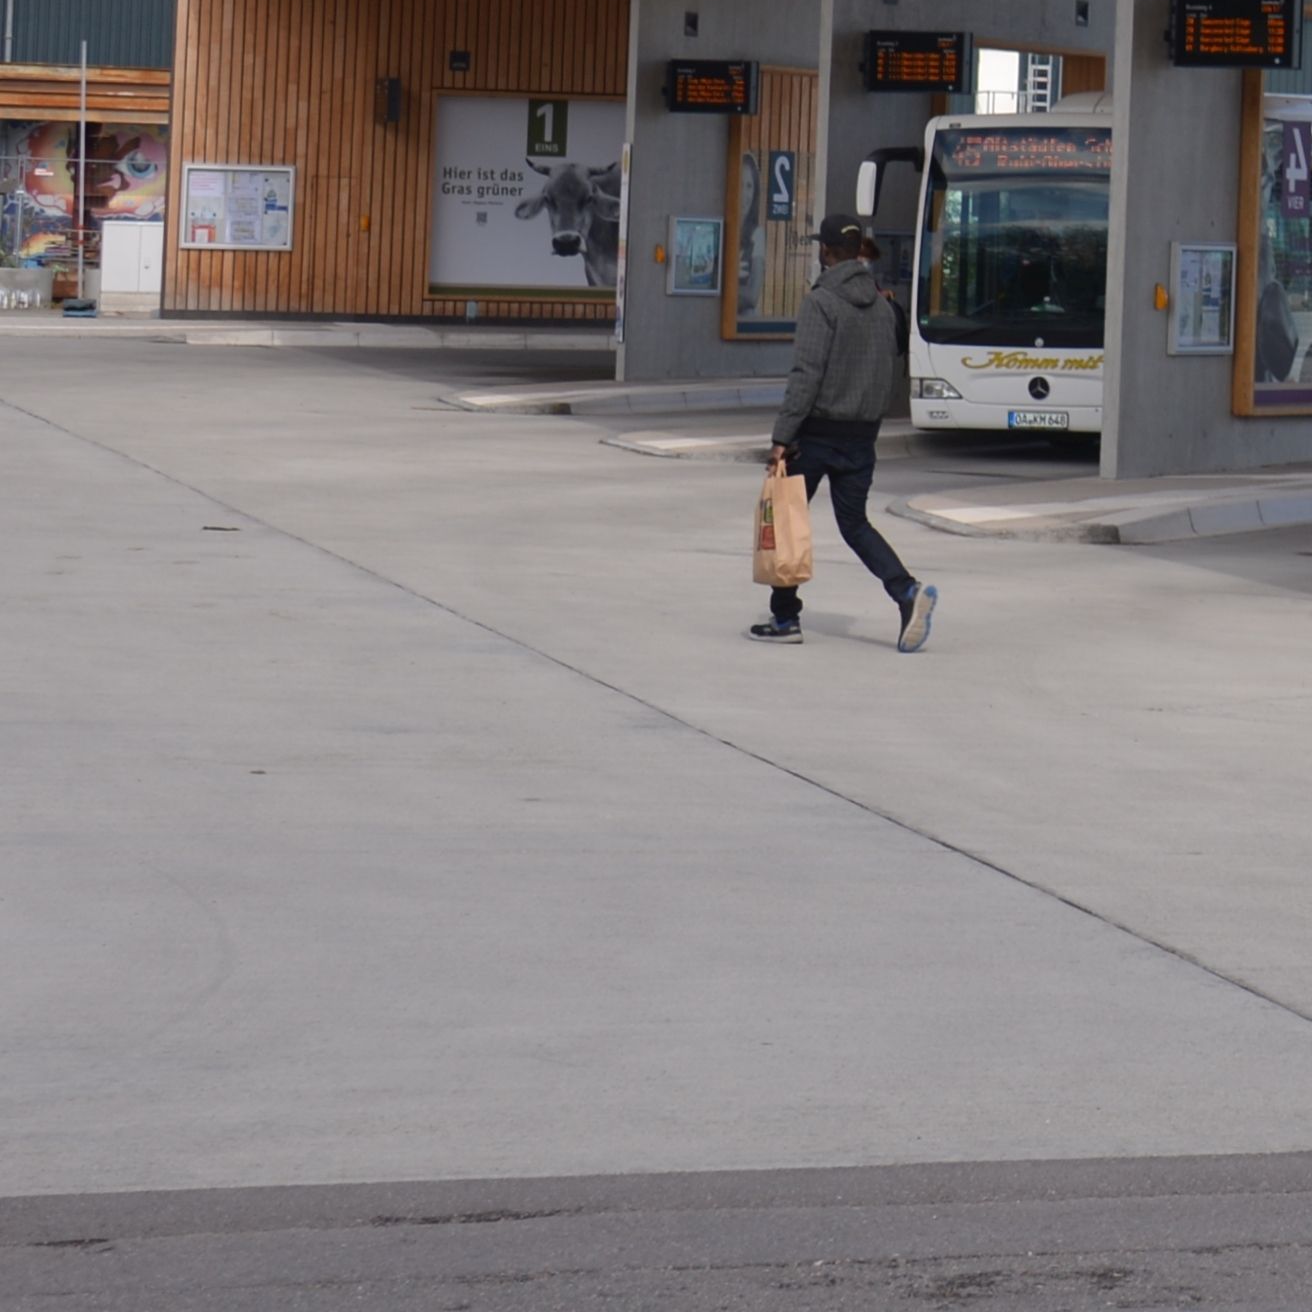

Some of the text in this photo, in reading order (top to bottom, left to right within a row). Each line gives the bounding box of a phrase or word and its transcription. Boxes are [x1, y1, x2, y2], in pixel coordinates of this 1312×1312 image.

[536, 102, 554, 143] 1
[534, 143, 559, 153] EINS
[442, 167, 524, 182] Hier ist das
[441, 182, 524, 199] Gras grüner
[961, 351, 1104, 370] Komm mit
